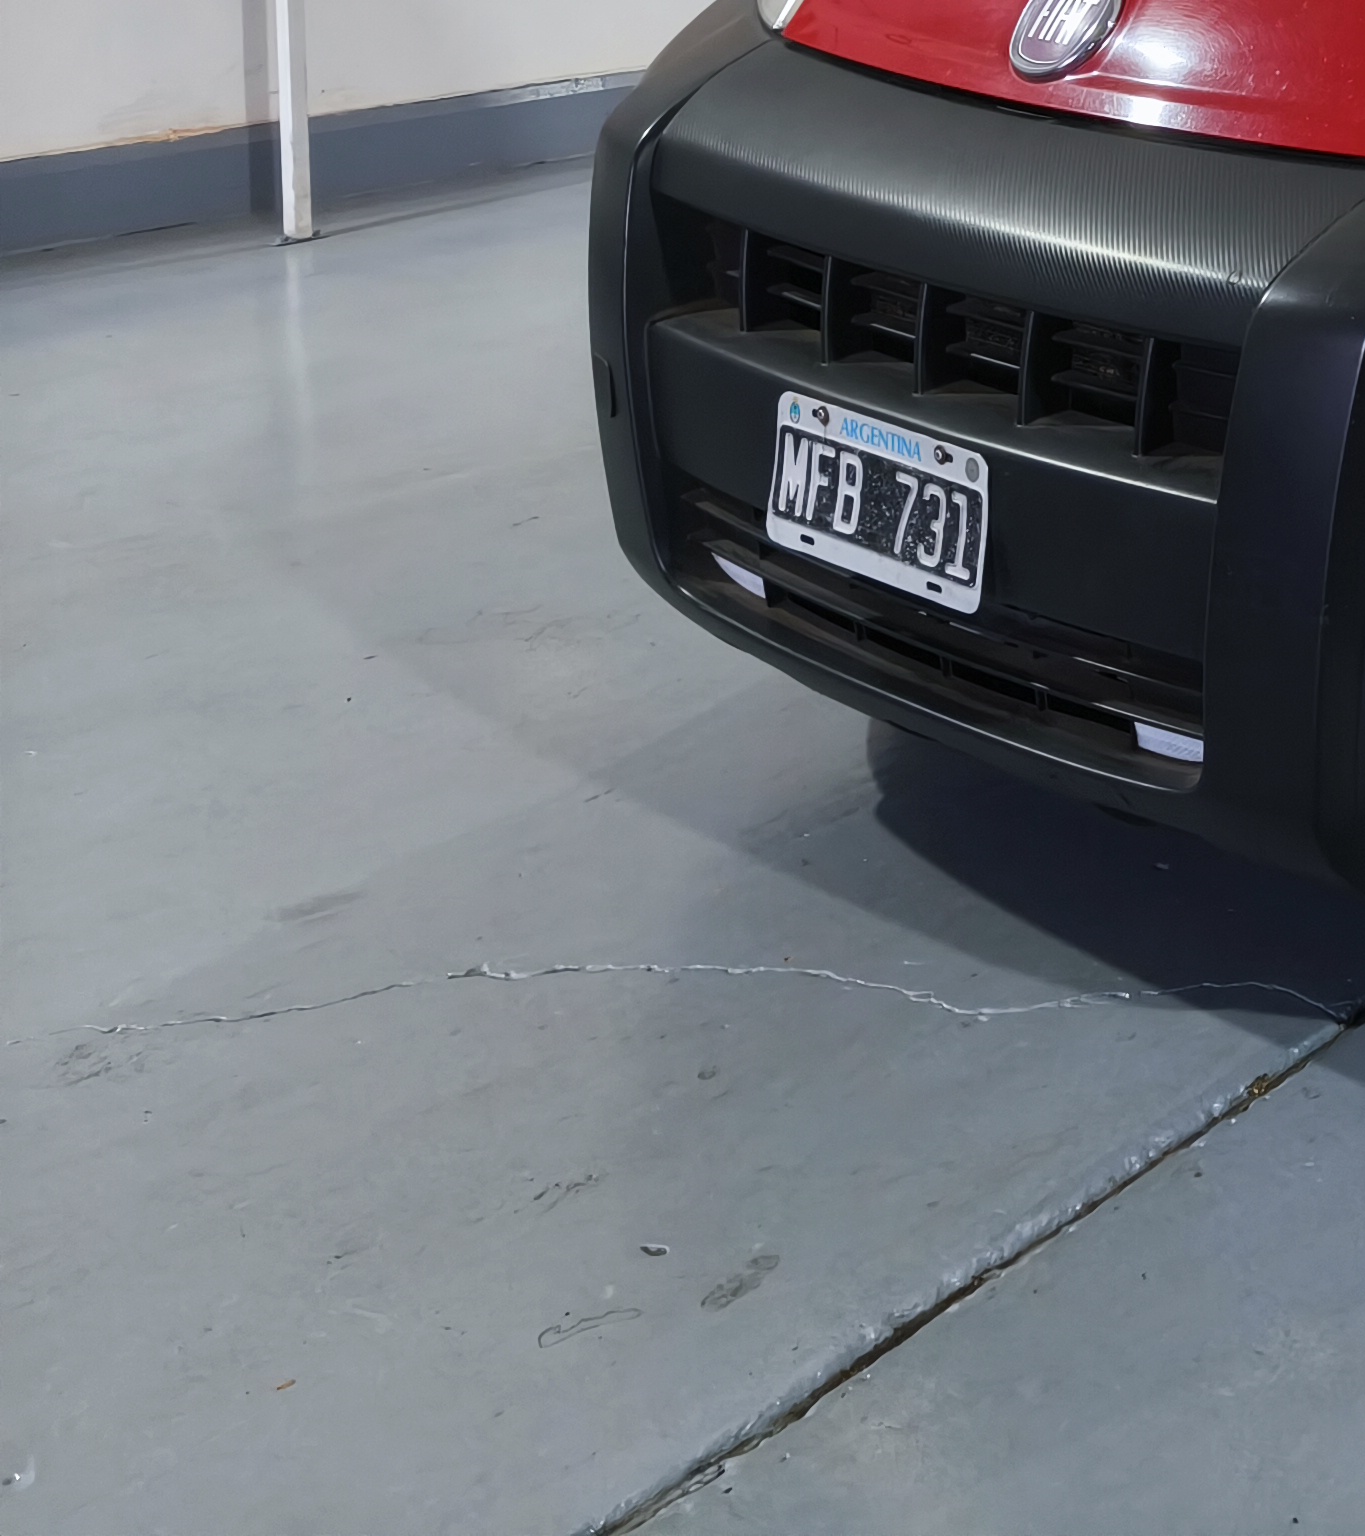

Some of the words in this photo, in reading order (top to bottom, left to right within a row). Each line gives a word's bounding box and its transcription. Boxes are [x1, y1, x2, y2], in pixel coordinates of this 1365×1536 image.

[839, 417, 922, 462] ARGENTINA
[778, 431, 863, 535] MFB
[893, 470, 970, 581] 731
